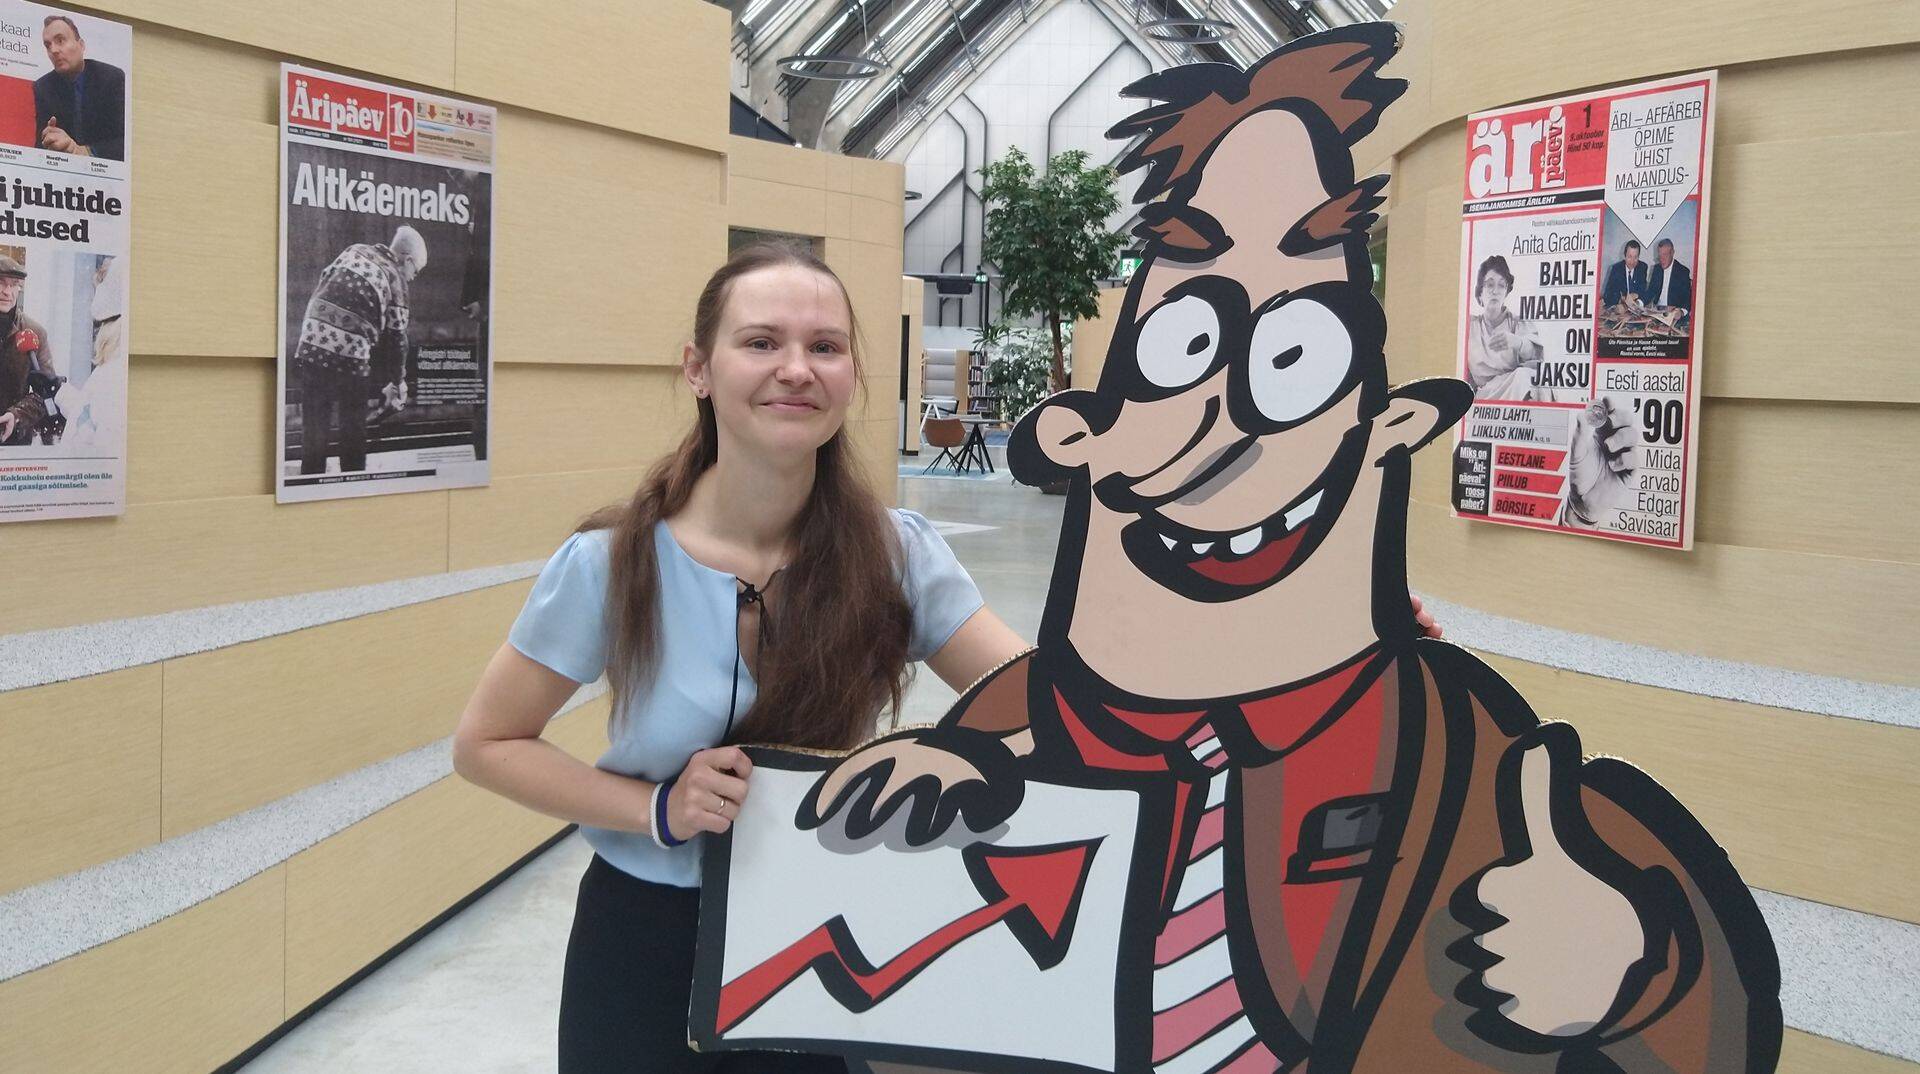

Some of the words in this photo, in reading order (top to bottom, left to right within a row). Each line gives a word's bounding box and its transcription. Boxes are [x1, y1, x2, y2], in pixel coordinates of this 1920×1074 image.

[291, 80, 384, 133] Äripäev
[1583, 104, 1592, 128] 1
[1611, 110, 1632, 130] ÄRI
[1646, 100, 1702, 124] AFFÄRER
[390, 101, 414, 138] 10
[1634, 126, 1675, 147] ÕPIME
[1468, 105, 1566, 198] äri
[1546, 122, 1565, 184] päev
[1634, 147, 1672, 167] ÜHIST
[1615, 166, 1689, 190] MAJANDUS-
[12, 178, 122, 216] juhtide
[292, 162, 470, 226] Altkäemaks
[1469, 199, 1526, 212] ISEMAJANDAMISE
[1527, 195, 1556, 207] ÄRILEHT
[1632, 189, 1669, 208] KEELT
[0, 210, 90, 243] dused
[1512, 234, 1544, 255] Anita
[1548, 230, 1595, 253] Gradin:
[1540, 259, 1594, 286] BALTI-
[1520, 294, 1592, 320] MAADEL
[1566, 328, 1591, 353] ON
[1531, 363, 1590, 388] JAKSU
[1607, 369, 1639, 390] Eesti
[1643, 370, 1685, 392] aastal
[1472, 406, 1500, 419] PIIRID
[1502, 408, 1532, 424] LAHTI,
[1633, 398, 1683, 445] '90
[1472, 425, 1507, 439] LIIKLUS
[1508, 427, 1535, 441] KINNI
[1460, 447, 1477, 458] Miks
[1478, 450, 1487, 460] on
[1498, 452, 1545, 470] EESTLANE
[1646, 449, 1680, 470] Mida
[18, 483, 47, 492] gaasiga
[45, 472, 83, 482] eesmärgil
[84, 472, 100, 480] olen
[101, 472, 113, 480] üle
[1497, 474, 1528, 489] PIILUB
[1640, 473, 1680, 493] arvab
[1461, 498, 1484, 511] paber?
[1466, 487, 1485, 498] roosa
[1637, 492, 1679, 518] Edgar
[1618, 511, 1678, 538] Savisaar
